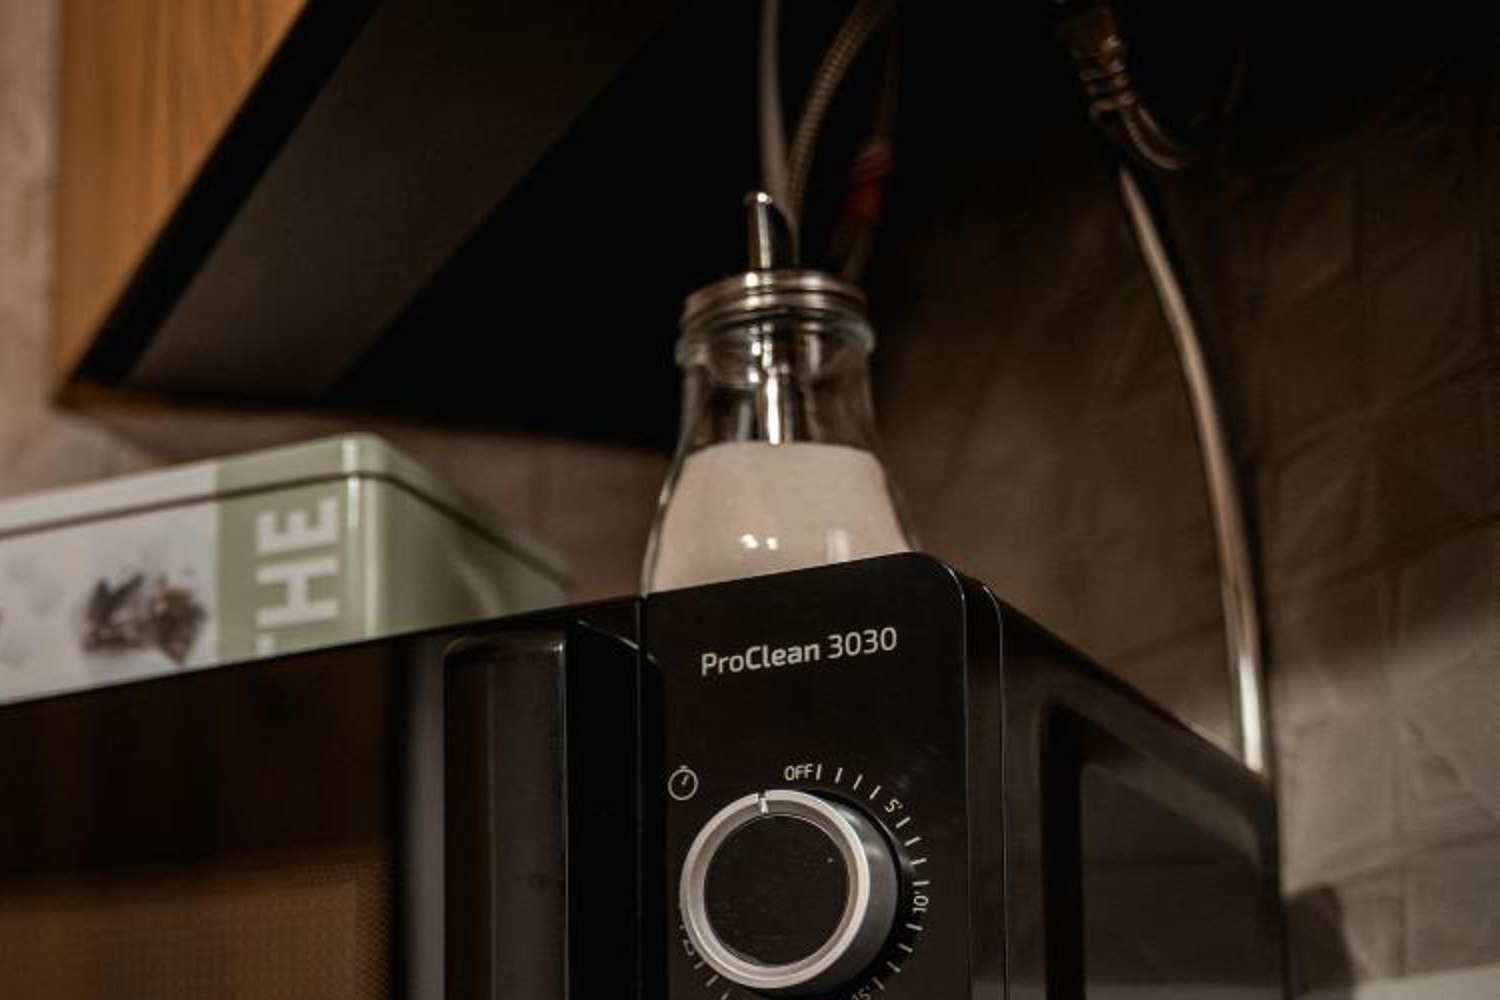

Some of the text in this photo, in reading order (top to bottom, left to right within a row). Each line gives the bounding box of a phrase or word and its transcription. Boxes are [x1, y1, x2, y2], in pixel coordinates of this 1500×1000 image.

[256, 497, 340, 657] HE
[701, 627, 897, 676] ProClean 3030
[784, 764, 813, 781] OFF
